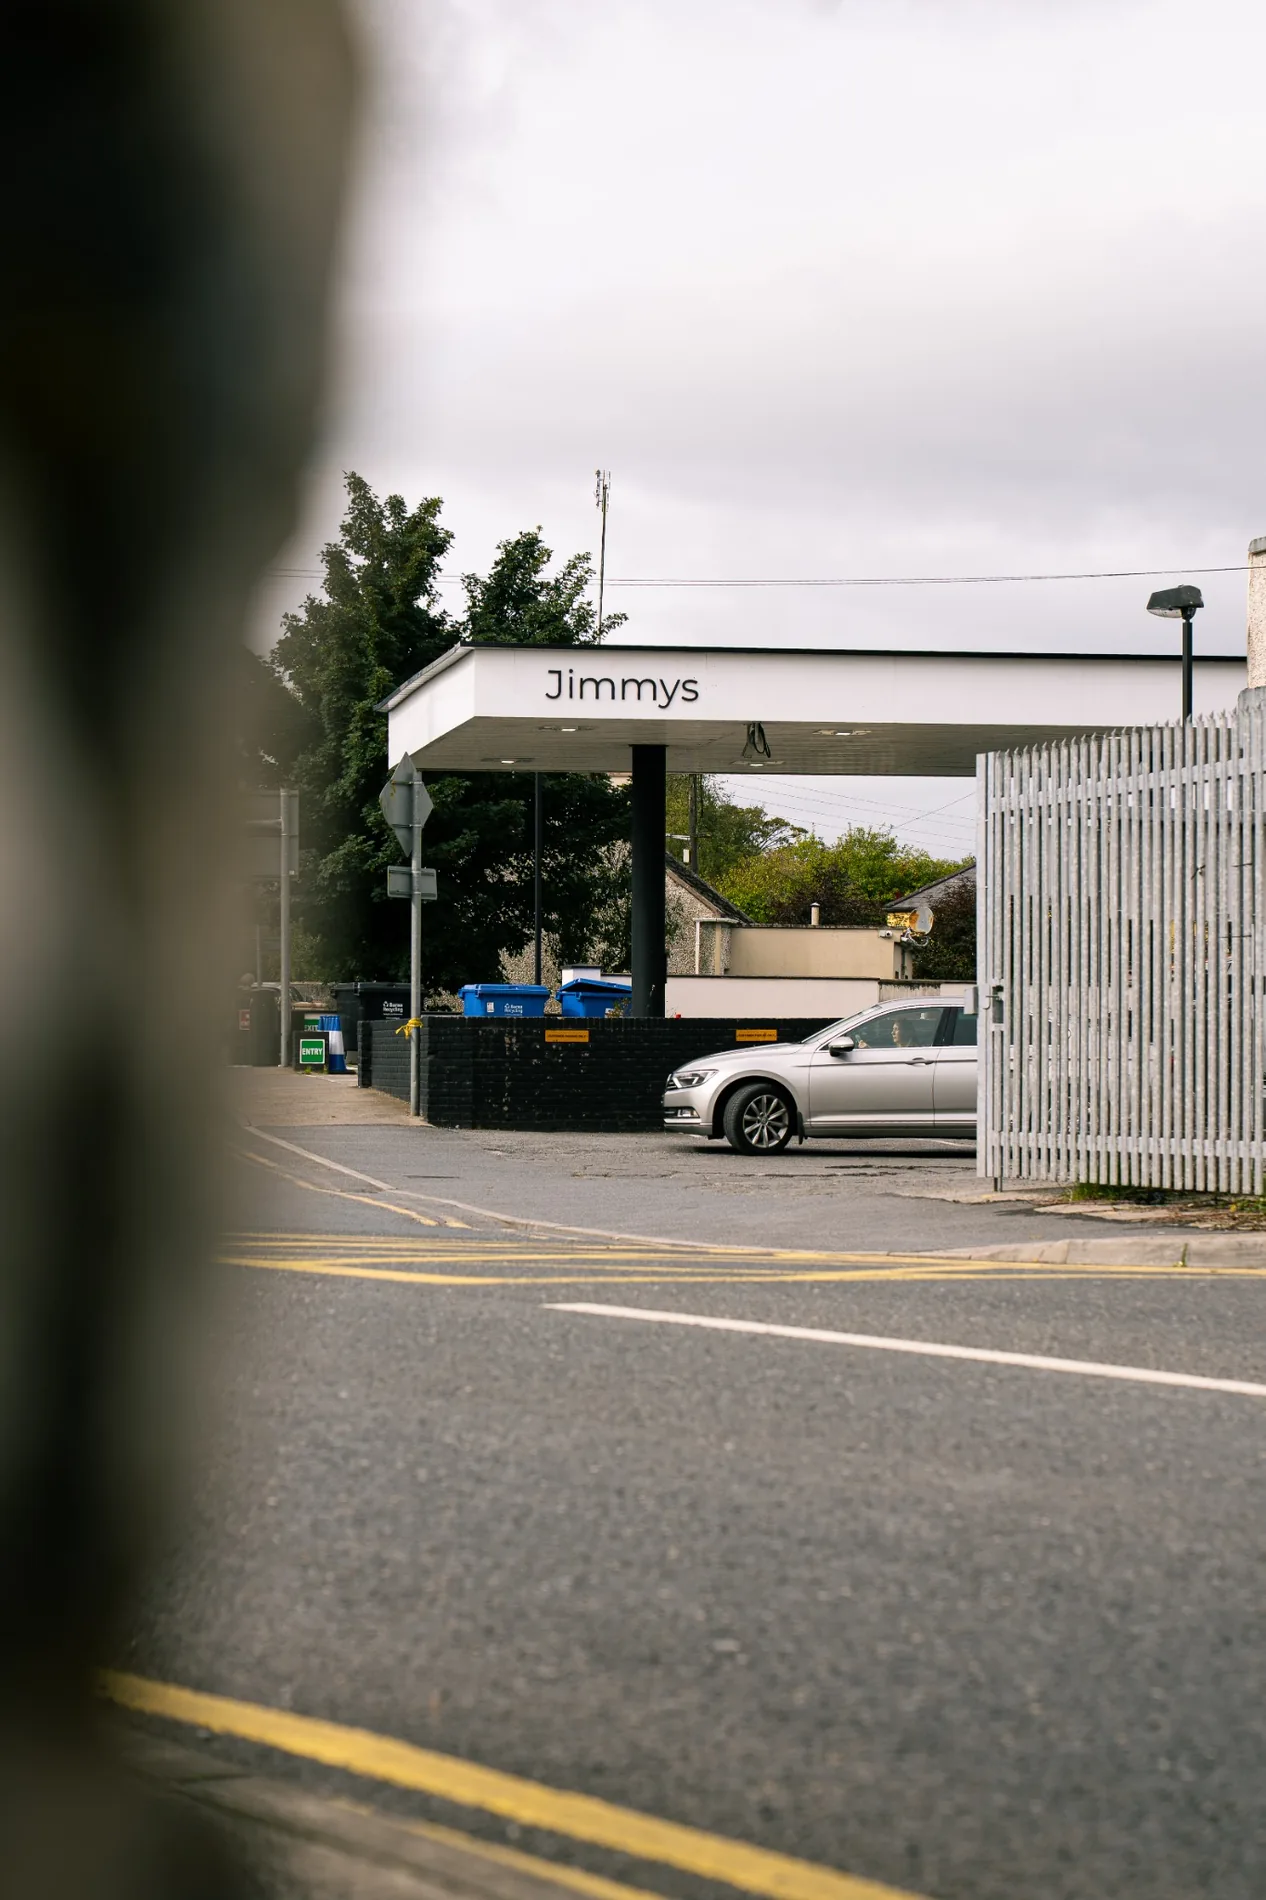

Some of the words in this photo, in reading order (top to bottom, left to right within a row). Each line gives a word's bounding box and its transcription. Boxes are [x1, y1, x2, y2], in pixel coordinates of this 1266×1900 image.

[545, 668, 699, 710] Jimmys
[304, 1024, 319, 1032] EXIT
[302, 1047, 323, 1055] ENTRY
